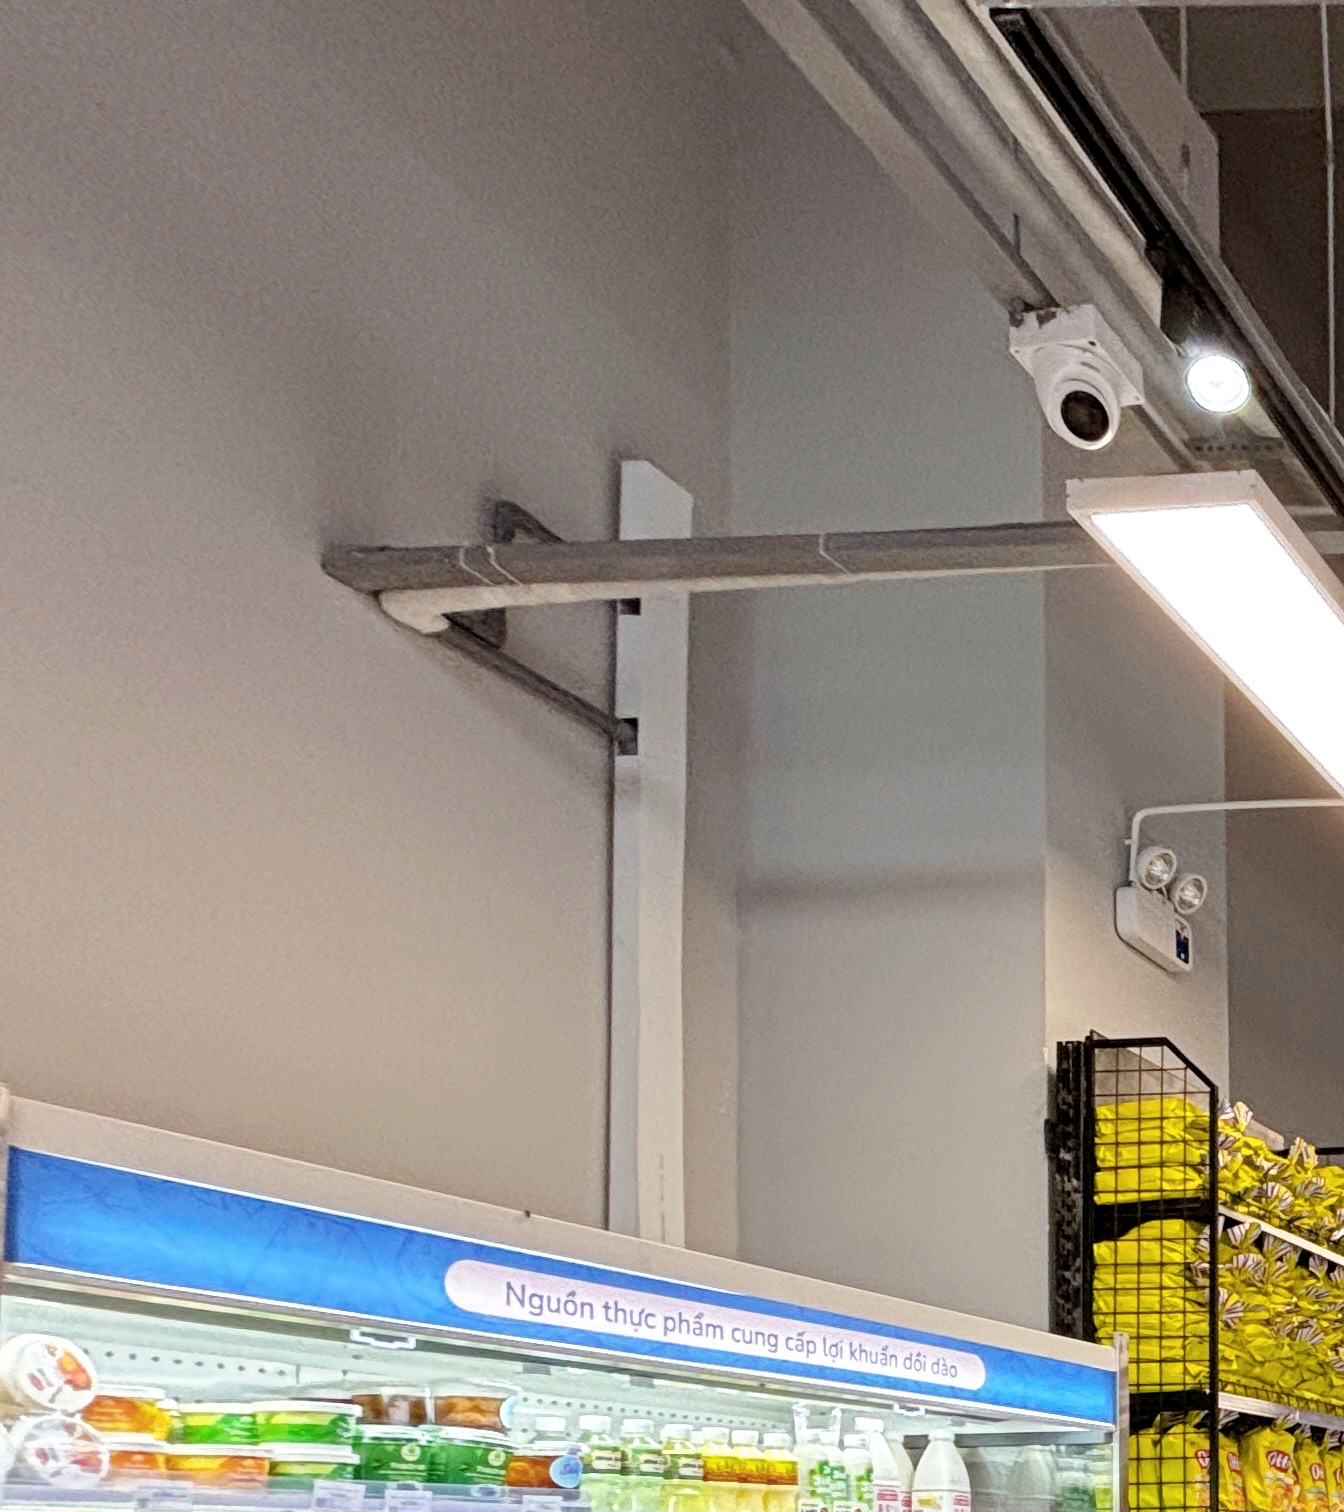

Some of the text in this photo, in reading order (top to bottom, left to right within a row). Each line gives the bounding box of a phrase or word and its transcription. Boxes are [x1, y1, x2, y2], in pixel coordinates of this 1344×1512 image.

[505, 1281, 959, 1379] Nguồn thực phẩm cung cấp lợi khuẩn dồi dào
